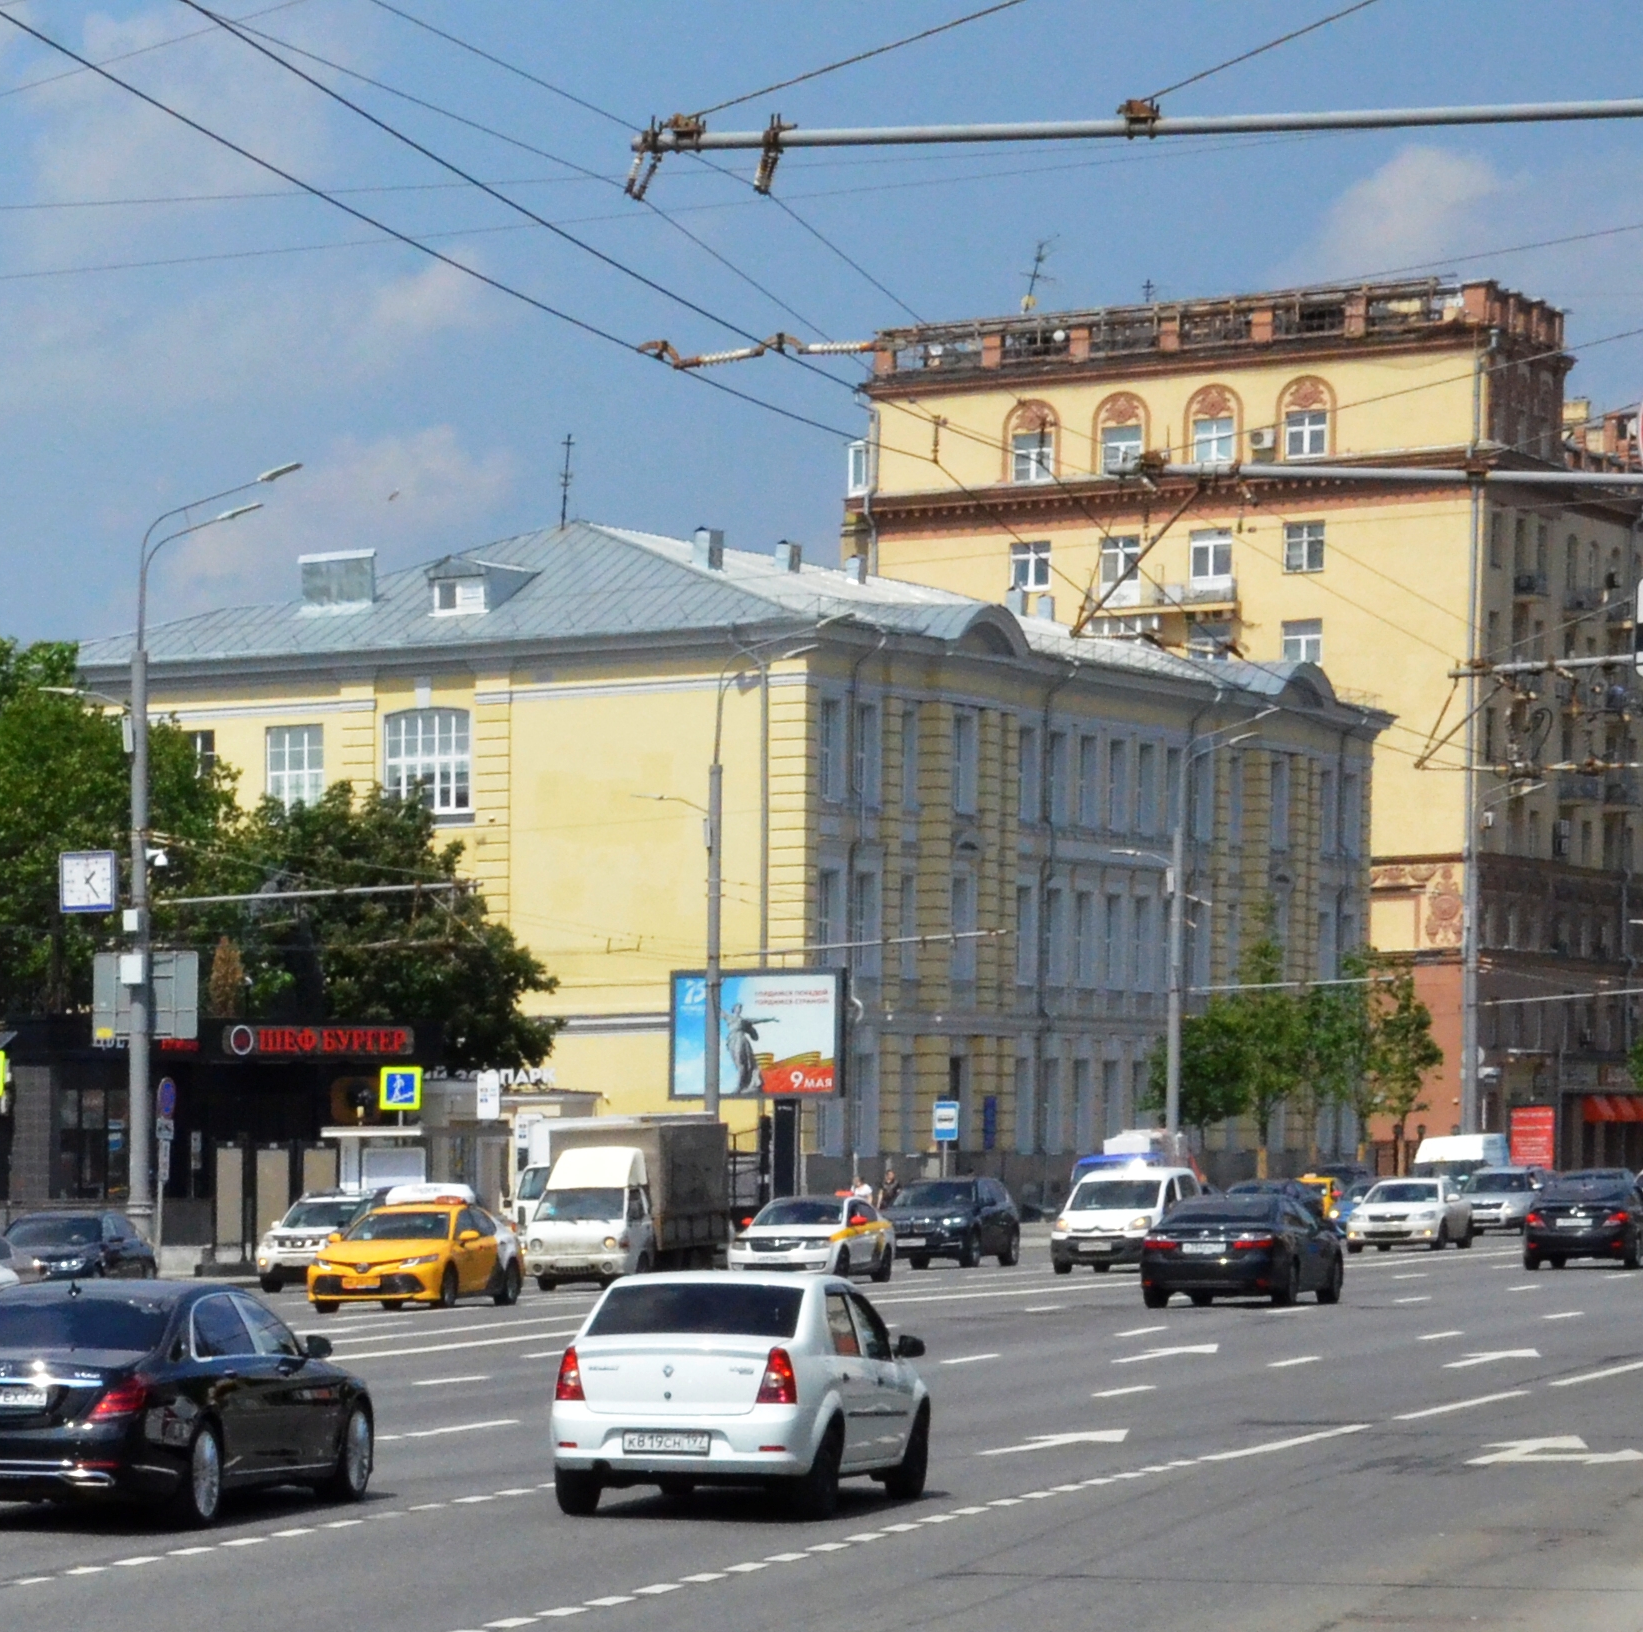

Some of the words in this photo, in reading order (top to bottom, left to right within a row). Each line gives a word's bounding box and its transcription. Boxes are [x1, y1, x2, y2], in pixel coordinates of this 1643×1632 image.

[258, 1028, 318, 1051] ШЕФ
[321, 1030, 407, 1051] БУРГЕР
[790, 1071, 803, 1088] 9
[803, 1076, 833, 1089] МАЯ
[627, 1432, 682, 1448] К819СН
[684, 1433, 706, 1445] 197
